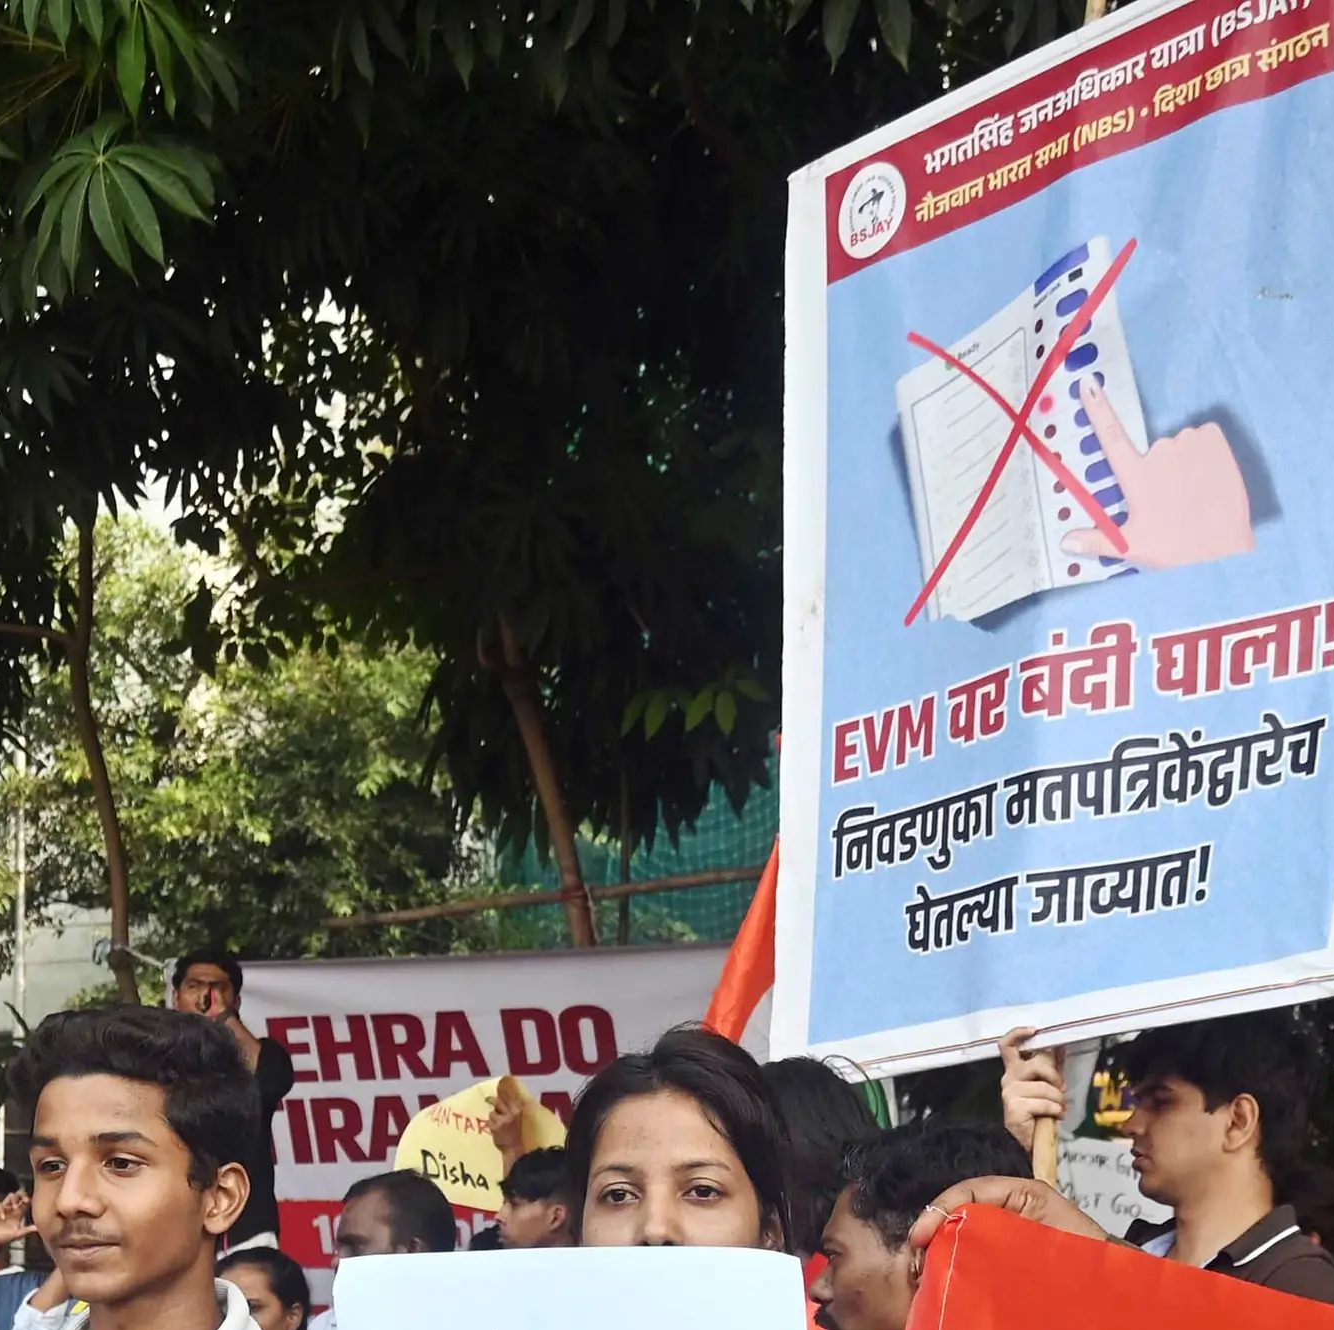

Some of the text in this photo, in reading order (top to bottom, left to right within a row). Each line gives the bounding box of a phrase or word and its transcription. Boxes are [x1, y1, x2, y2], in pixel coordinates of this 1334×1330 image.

[914, 176, 985, 223] नौजवान
[988, 155, 1034, 191] भारत
[1034, 133, 1070, 170] सभा
[1072, 106, 1135, 152] (NBS)
[1154, 74, 1203, 117] दिशा
[1205, 53, 1252, 92] छात्र
[1255, 22, 1331, 72] संगठन
[923, 114, 1016, 175] भगतसिंह
[1017, 49, 1147, 136] जनअधिकार
[1149, 23, 1206, 69] यात्रा
[850, 216, 894, 247] BSJAY
[832, 696, 935, 781] EVM
[948, 669, 1012, 742] वर
[1020, 623, 1136, 716] बंदी
[832, 714, 1326, 877] निवडणुका मतपत्रिकेंद्वारेच
[906, 846, 1212, 952] घेतल्या जाव्यात!
[266, 1005, 617, 1082] EHRA DO
[420, 1149, 489, 1191] Disha
